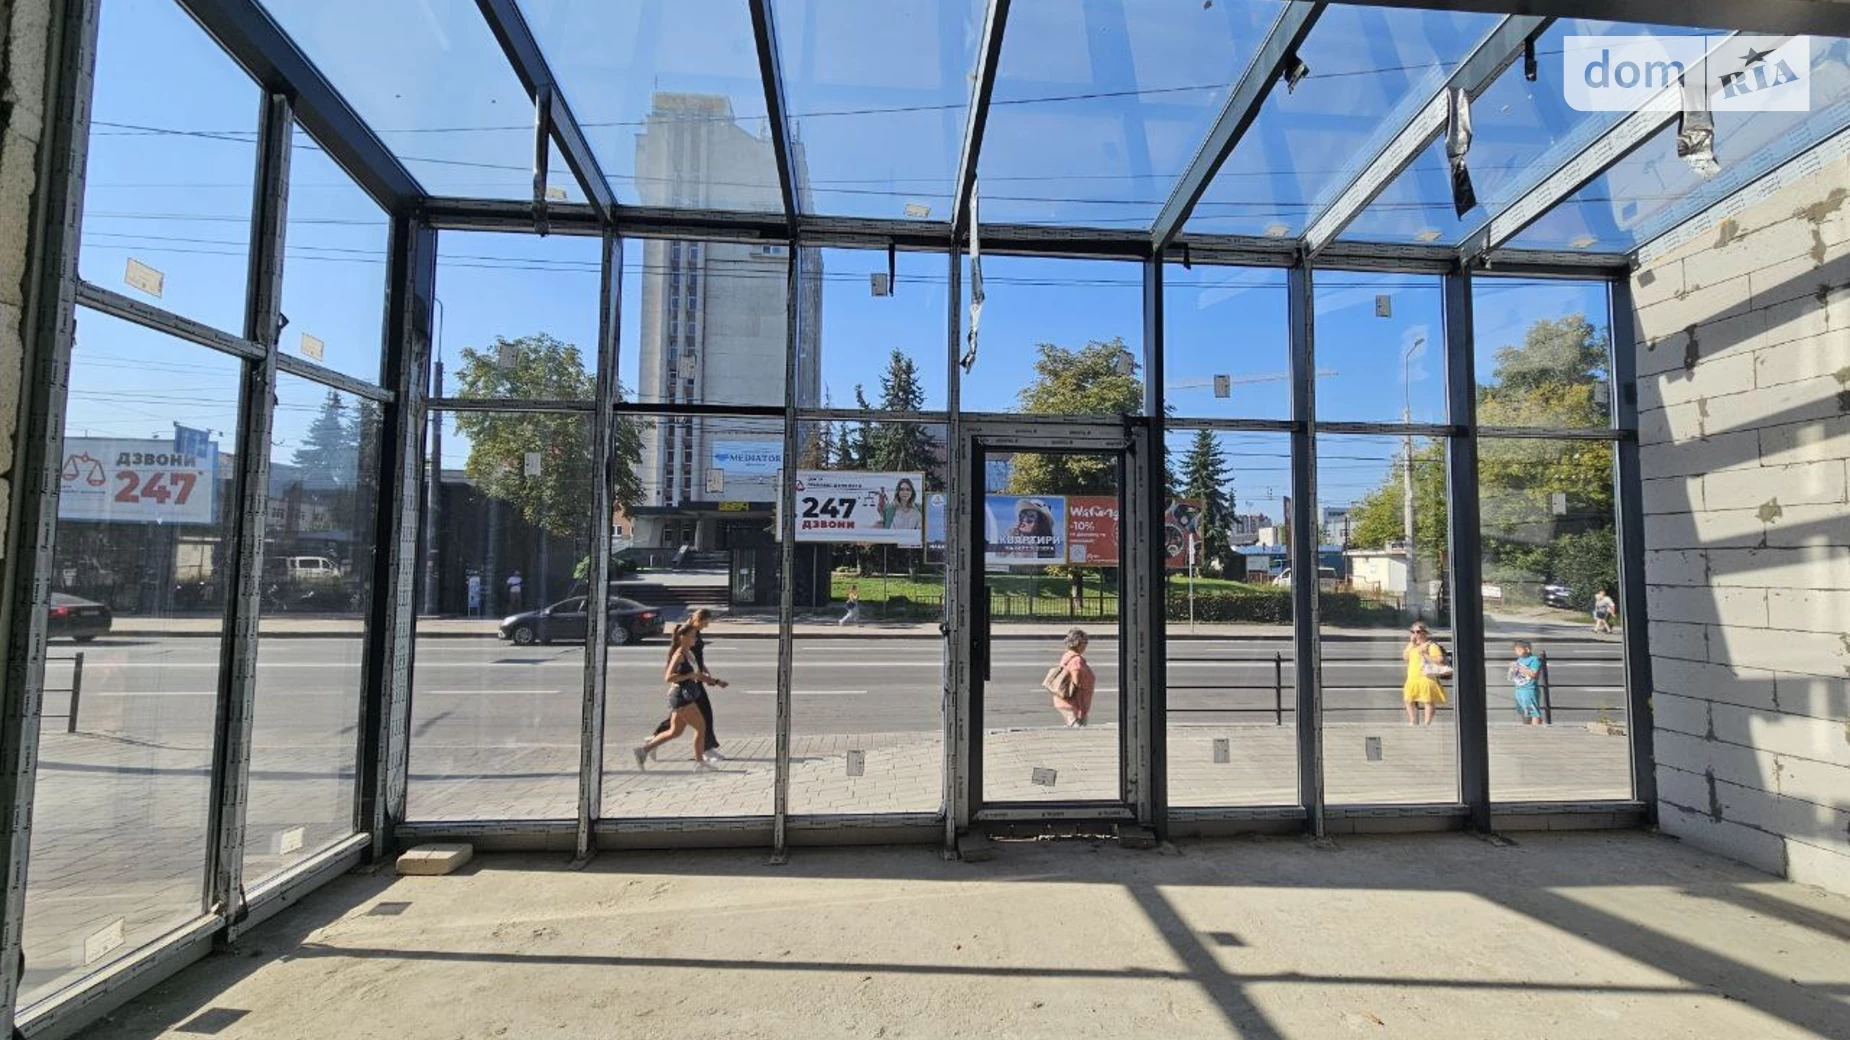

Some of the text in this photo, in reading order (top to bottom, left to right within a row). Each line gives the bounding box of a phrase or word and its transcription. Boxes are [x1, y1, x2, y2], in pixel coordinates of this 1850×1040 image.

[115, 451, 197, 468] ДЗВОНИ
[729, 453, 782, 462] MEDIATOR
[114, 469, 198, 505] 247
[801, 496, 857, 519] 247
[801, 520, 856, 530] ДЗВОНИ
[999, 535, 1061, 545] КВАРТИРИ
